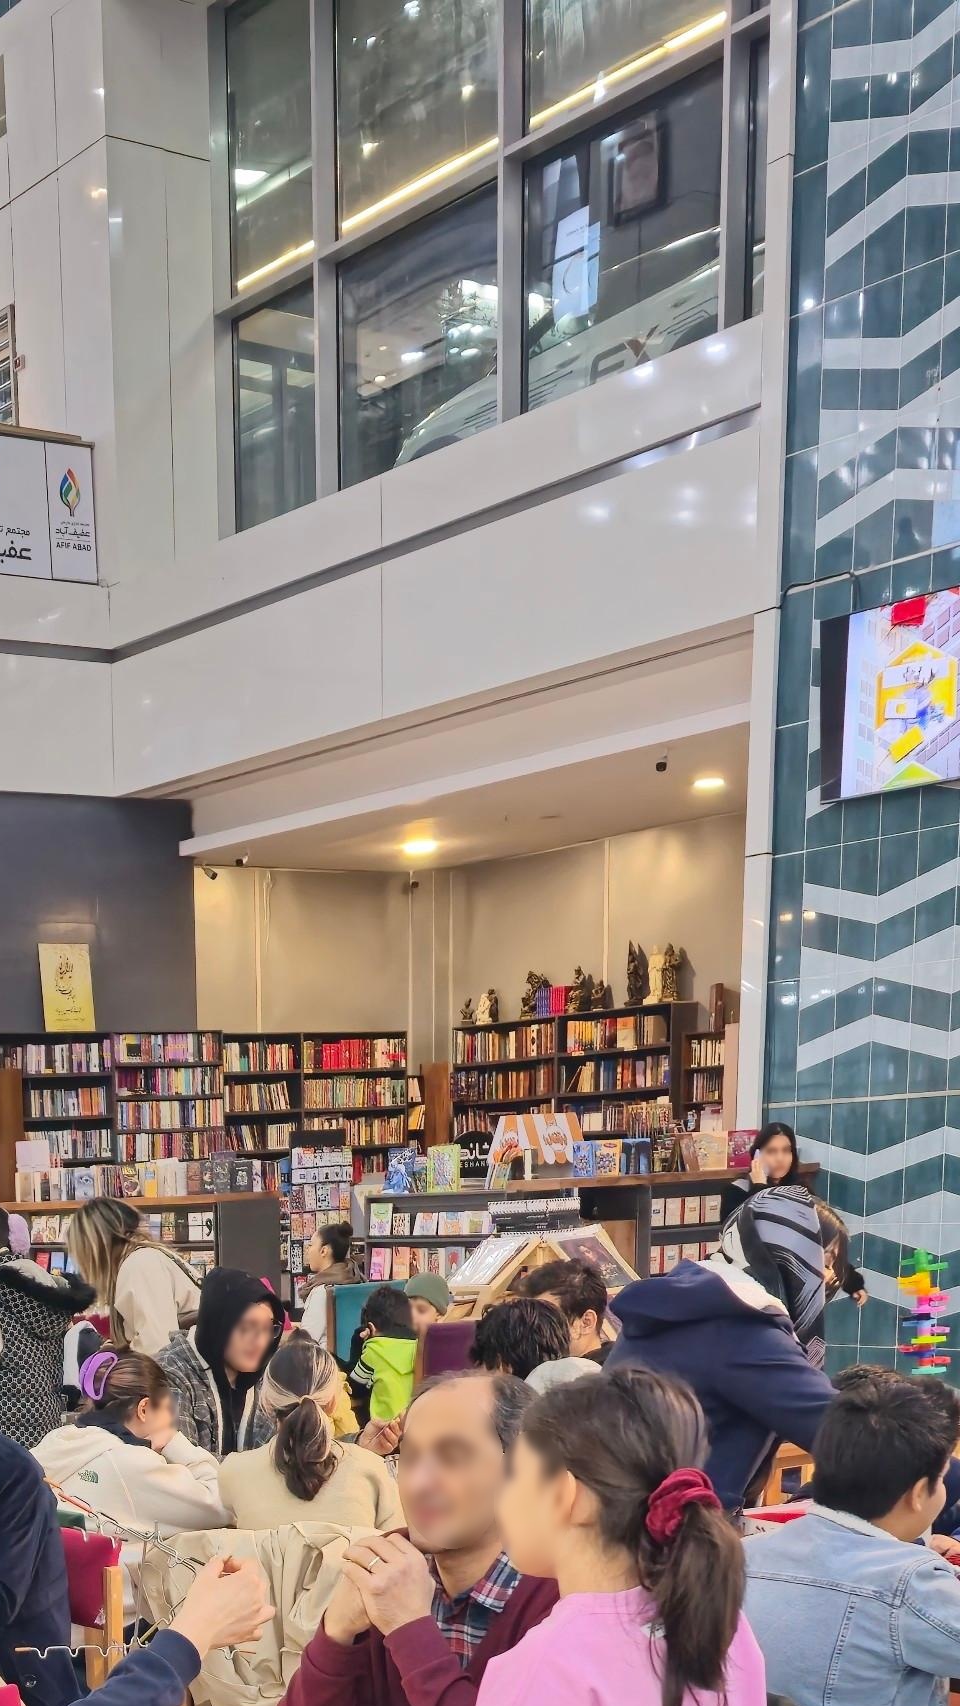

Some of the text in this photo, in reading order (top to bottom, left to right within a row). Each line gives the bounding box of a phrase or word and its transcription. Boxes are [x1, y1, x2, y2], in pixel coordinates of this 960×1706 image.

[6, 529, 30, 538] مجتمع
[56, 541, 92, 551] AFIF ABAD
